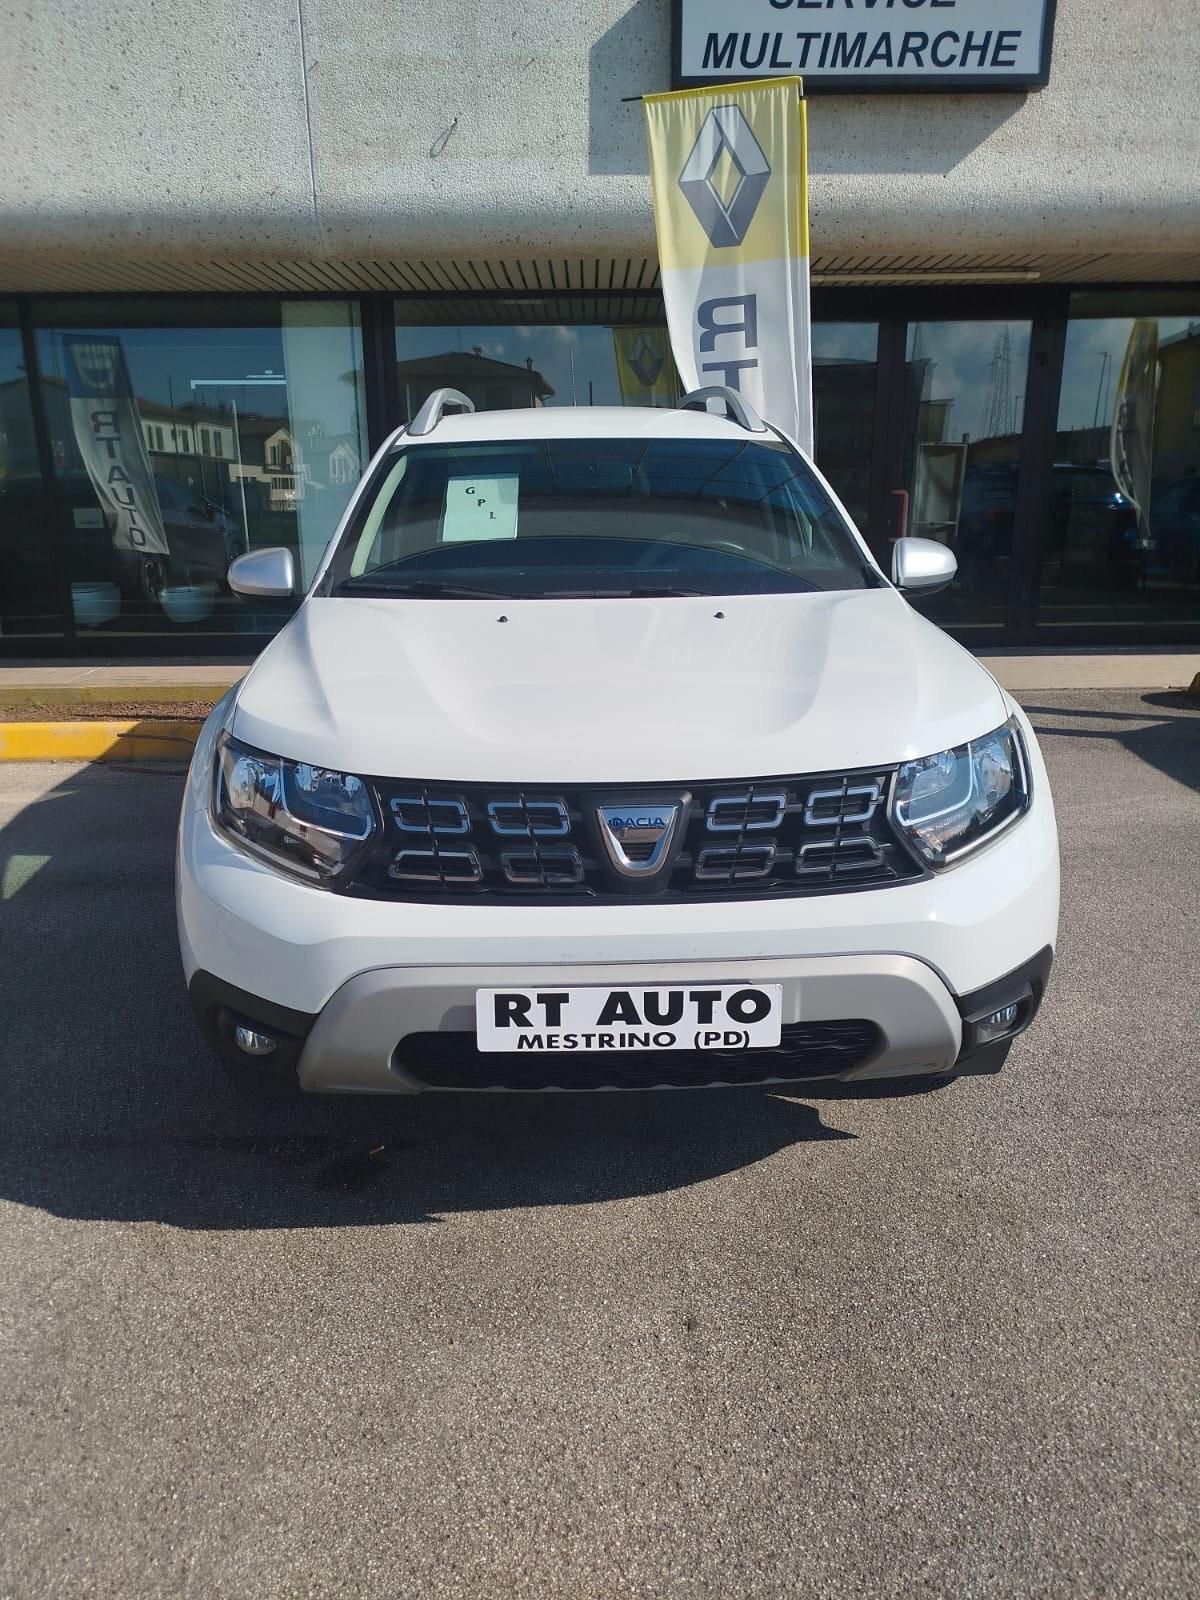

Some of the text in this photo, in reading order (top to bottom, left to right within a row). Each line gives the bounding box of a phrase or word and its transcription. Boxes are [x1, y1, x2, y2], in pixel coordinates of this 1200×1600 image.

[702, 30, 1023, 69] MULTIMARCHE
[609, 817, 665, 829] DACIA
[494, 988, 772, 1028] RT AUTO
[517, 1030, 750, 1050] MESTRINO (PD)
